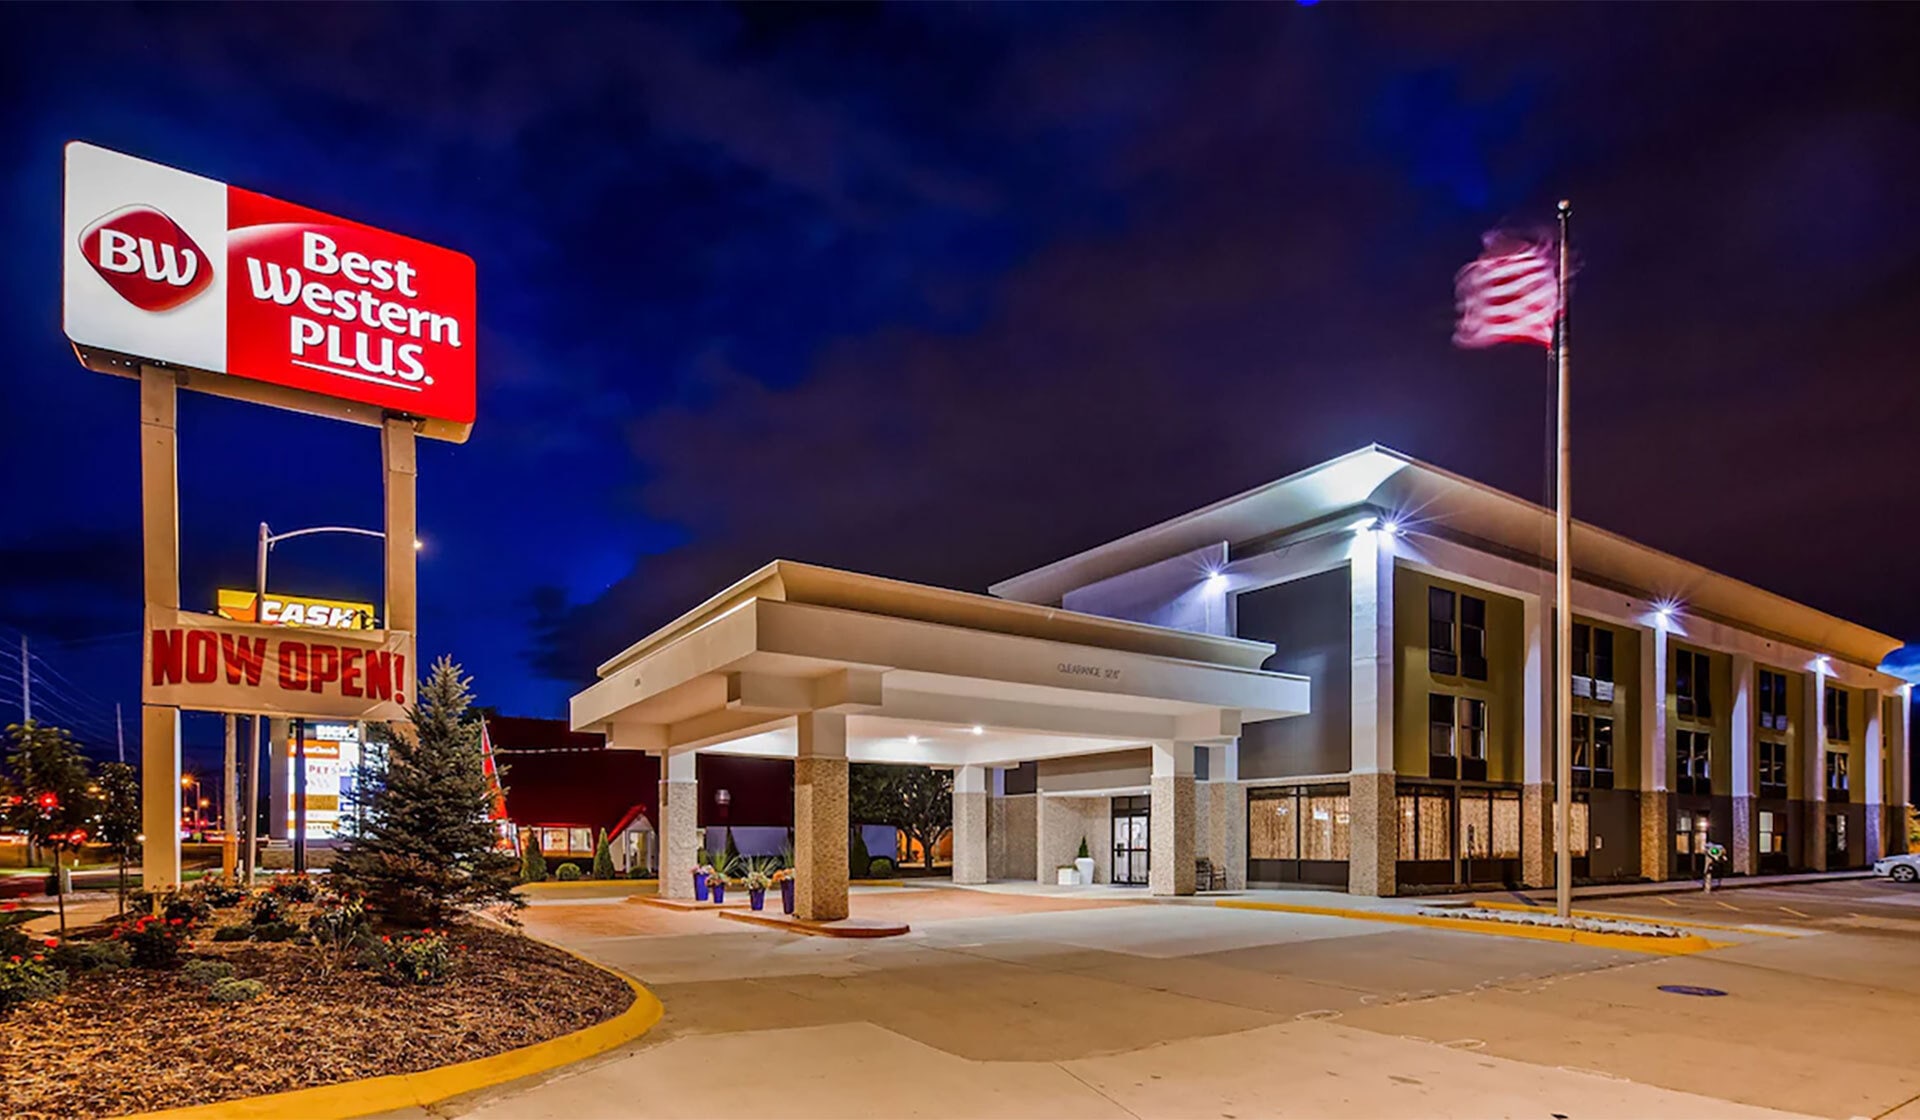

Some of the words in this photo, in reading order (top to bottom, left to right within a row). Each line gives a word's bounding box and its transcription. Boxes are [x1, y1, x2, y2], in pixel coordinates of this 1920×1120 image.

[100, 229, 198, 286] BW
[303, 231, 417, 298] Best
[247, 257, 461, 348] Western
[262, 601, 356, 628] CASH
[152, 629, 268, 687] NOW
[278, 641, 405, 705] OPEN!
